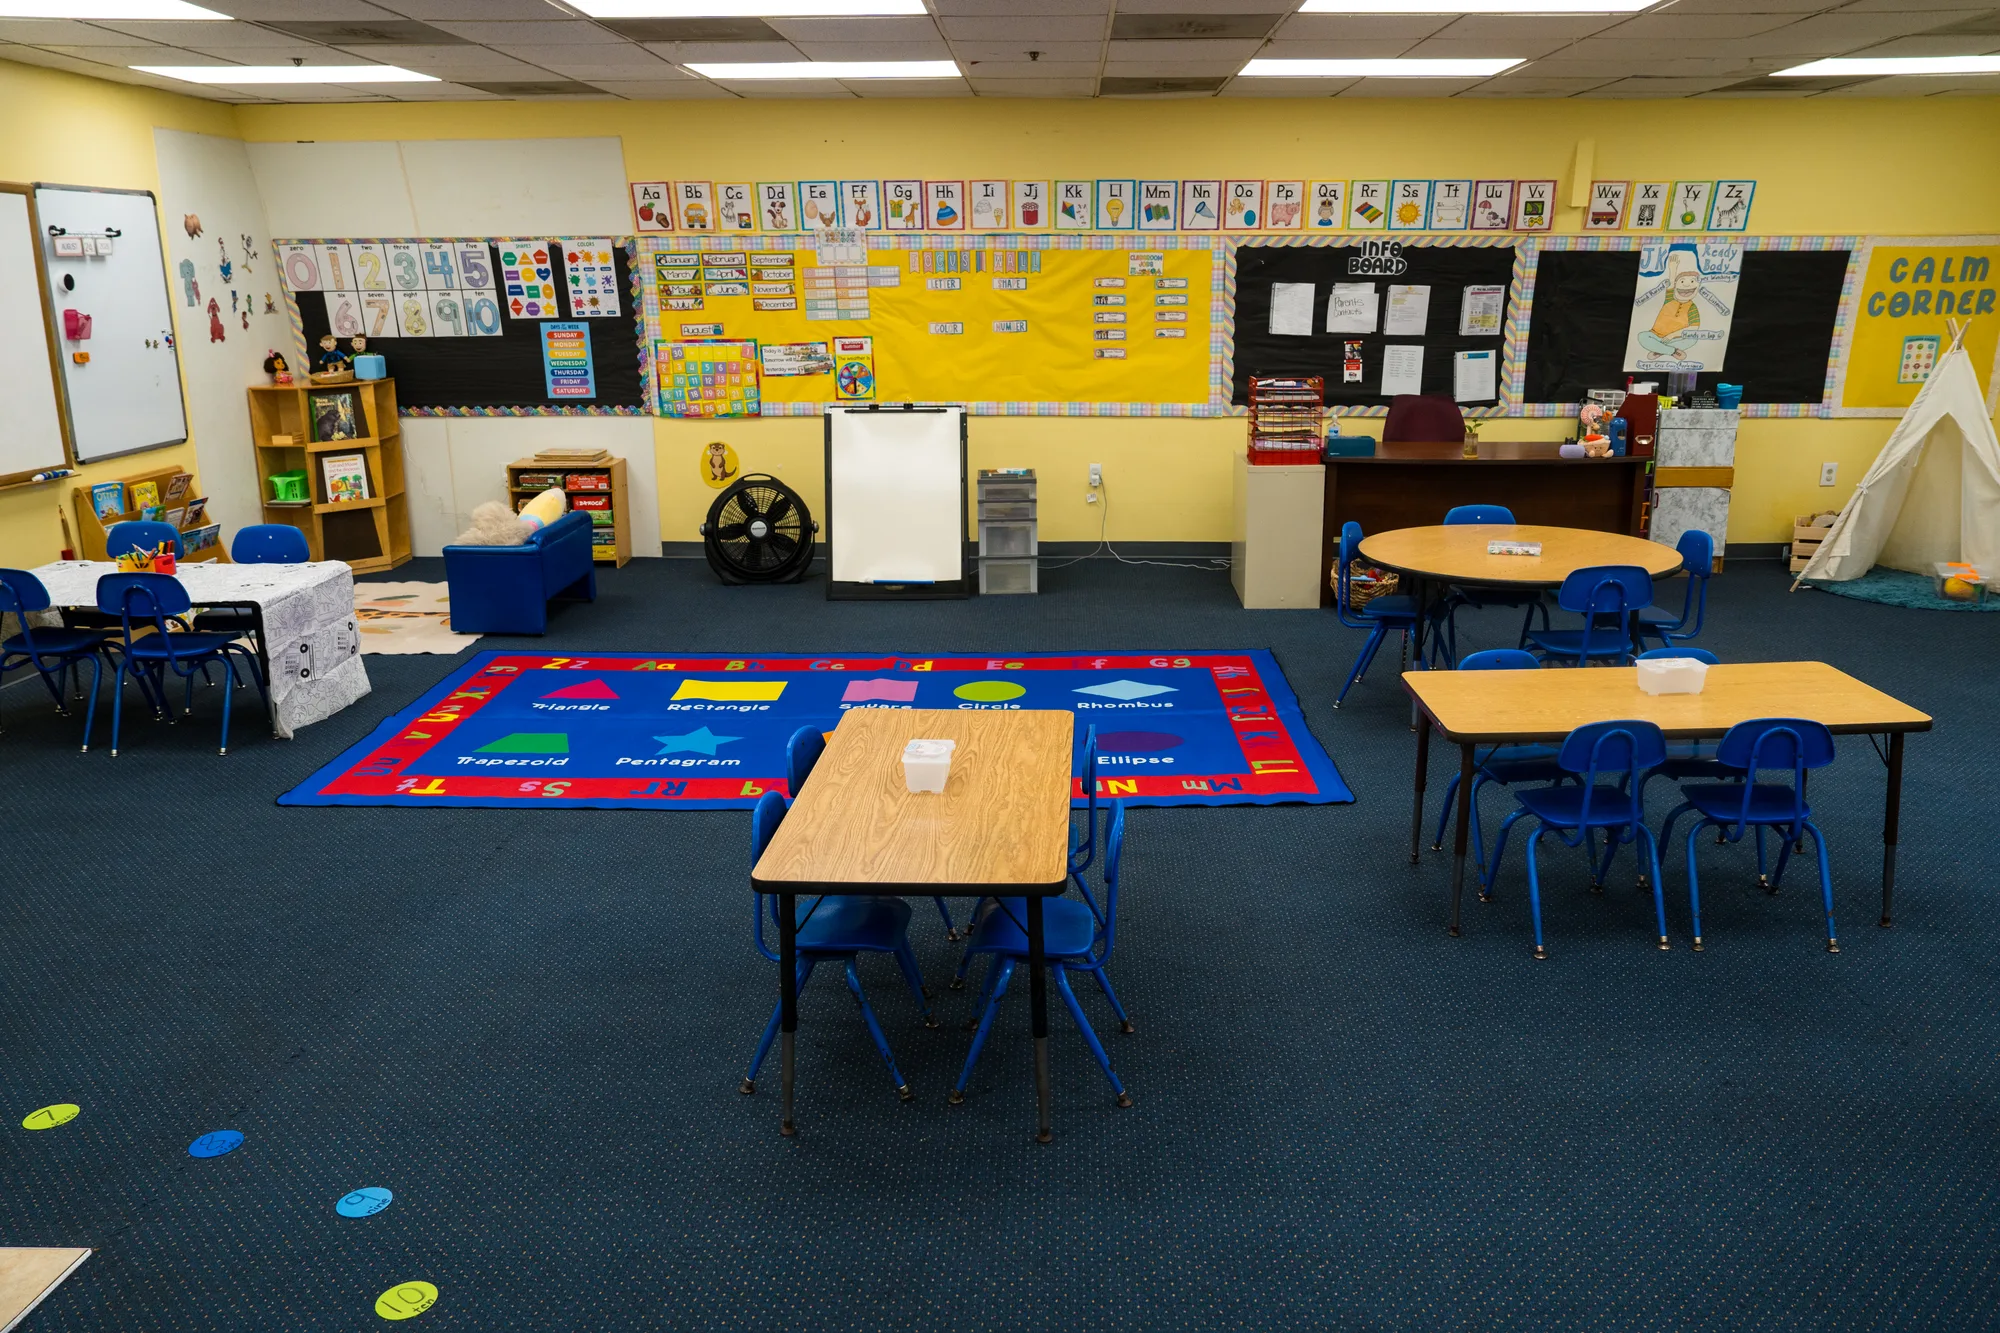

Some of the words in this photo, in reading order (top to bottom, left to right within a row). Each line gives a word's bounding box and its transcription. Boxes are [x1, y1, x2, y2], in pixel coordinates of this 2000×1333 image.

[642, 186, 661, 200] Aa
[685, 186, 702, 199] Bb
[725, 186, 743, 200] Cc
[767, 186, 785, 200] Dd
[809, 185, 827, 199] Ee
[852, 185, 868, 198] Ff
[894, 185, 912, 200] Gg
[936, 185, 954, 198] Hh
[983, 184, 994, 198] Ii
[1024, 184, 1039, 200] Jj
[1065, 185, 1082, 198] Kk
[1110, 184, 1122, 198] Ll
[1145, 185, 1170, 198] Mm
[1193, 185, 1211, 198] Nn
[1235, 184, 1253, 198] Oo
[1276, 185, 1294, 200] Pp
[1318, 184, 1338, 200] Qq
[1361, 185, 1378, 198] Rr
[1402, 184, 1419, 198] Ss
[1445, 184, 1460, 198] Tt
[1486, 184, 1503, 198] Uu
[1528, 185, 1545, 198] Vv
[1598, 185, 1622, 198] Ww
[1642, 185, 1659, 198] Xx
[1684, 184, 1700, 200] Yy
[1726, 185, 1742, 198] Zz
[1362, 241, 1402, 257] INFO
[1702, 245, 1738, 260] Ready
[667, 255, 698, 264] January
[708, 255, 743, 264] February
[752, 256, 789, 264] September
[911, 253, 969, 268] FOCUS
[995, 254, 1039, 268] WALL
[1349, 258, 1406, 275] BOARD
[1703, 259, 1730, 272] Body
[286, 253, 317, 290] 0
[329, 252, 344, 290] 1
[358, 252, 386, 289] 2
[394, 252, 419, 289] 3
[425, 252, 454, 288] 4
[460, 251, 488, 288] 5
[667, 270, 691, 278] March
[716, 270, 734, 279] April
[764, 270, 792, 278] October
[1890, 256, 1990, 284] CALM
[672, 286, 690, 294] May
[717, 286, 738, 294] June
[931, 280, 956, 288] LETTER
[998, 280, 1020, 288] SHAPE
[673, 302, 690, 310] July
[1334, 297, 1364, 308] Parents
[1868, 289, 1996, 318] CORNER
[335, 300, 358, 336] 6
[366, 300, 389, 336] 7
[403, 300, 426, 336] 8
[436, 299, 462, 335] 9
[464, 298, 500, 335] 10
[1334, 309, 1362, 317] Contacts
[684, 326, 712, 336] August
[935, 324, 958, 332] COLOR
[996, 322, 1024, 332] NUMBER
[661, 352, 668, 360] 31
[542, 658, 590, 670] Zz
[632, 661, 676, 670] Aa
[725, 661, 766, 670] Bb
[809, 660, 845, 670] Cc
[894, 660, 934, 672] Dd
[986, 660, 1024, 670] Ee
[1149, 658, 1191, 668] Gg
[532, 702, 610, 712] Triangle
[667, 704, 770, 712] Rectangle
[1078, 702, 1174, 710] Rhombus
[457, 756, 570, 766] Trapezoid
[616, 758, 741, 766] Pentagram
[1098, 756, 1174, 766] Ellipse
[31, 1109, 54, 1121] 7
[200, 1134, 226, 1150] 8
[345, 1192, 381, 1206] 9
[367, 1198, 390, 1214] nine
[381, 1287, 426, 1313] 10
[412, 1298, 434, 1312] ten
